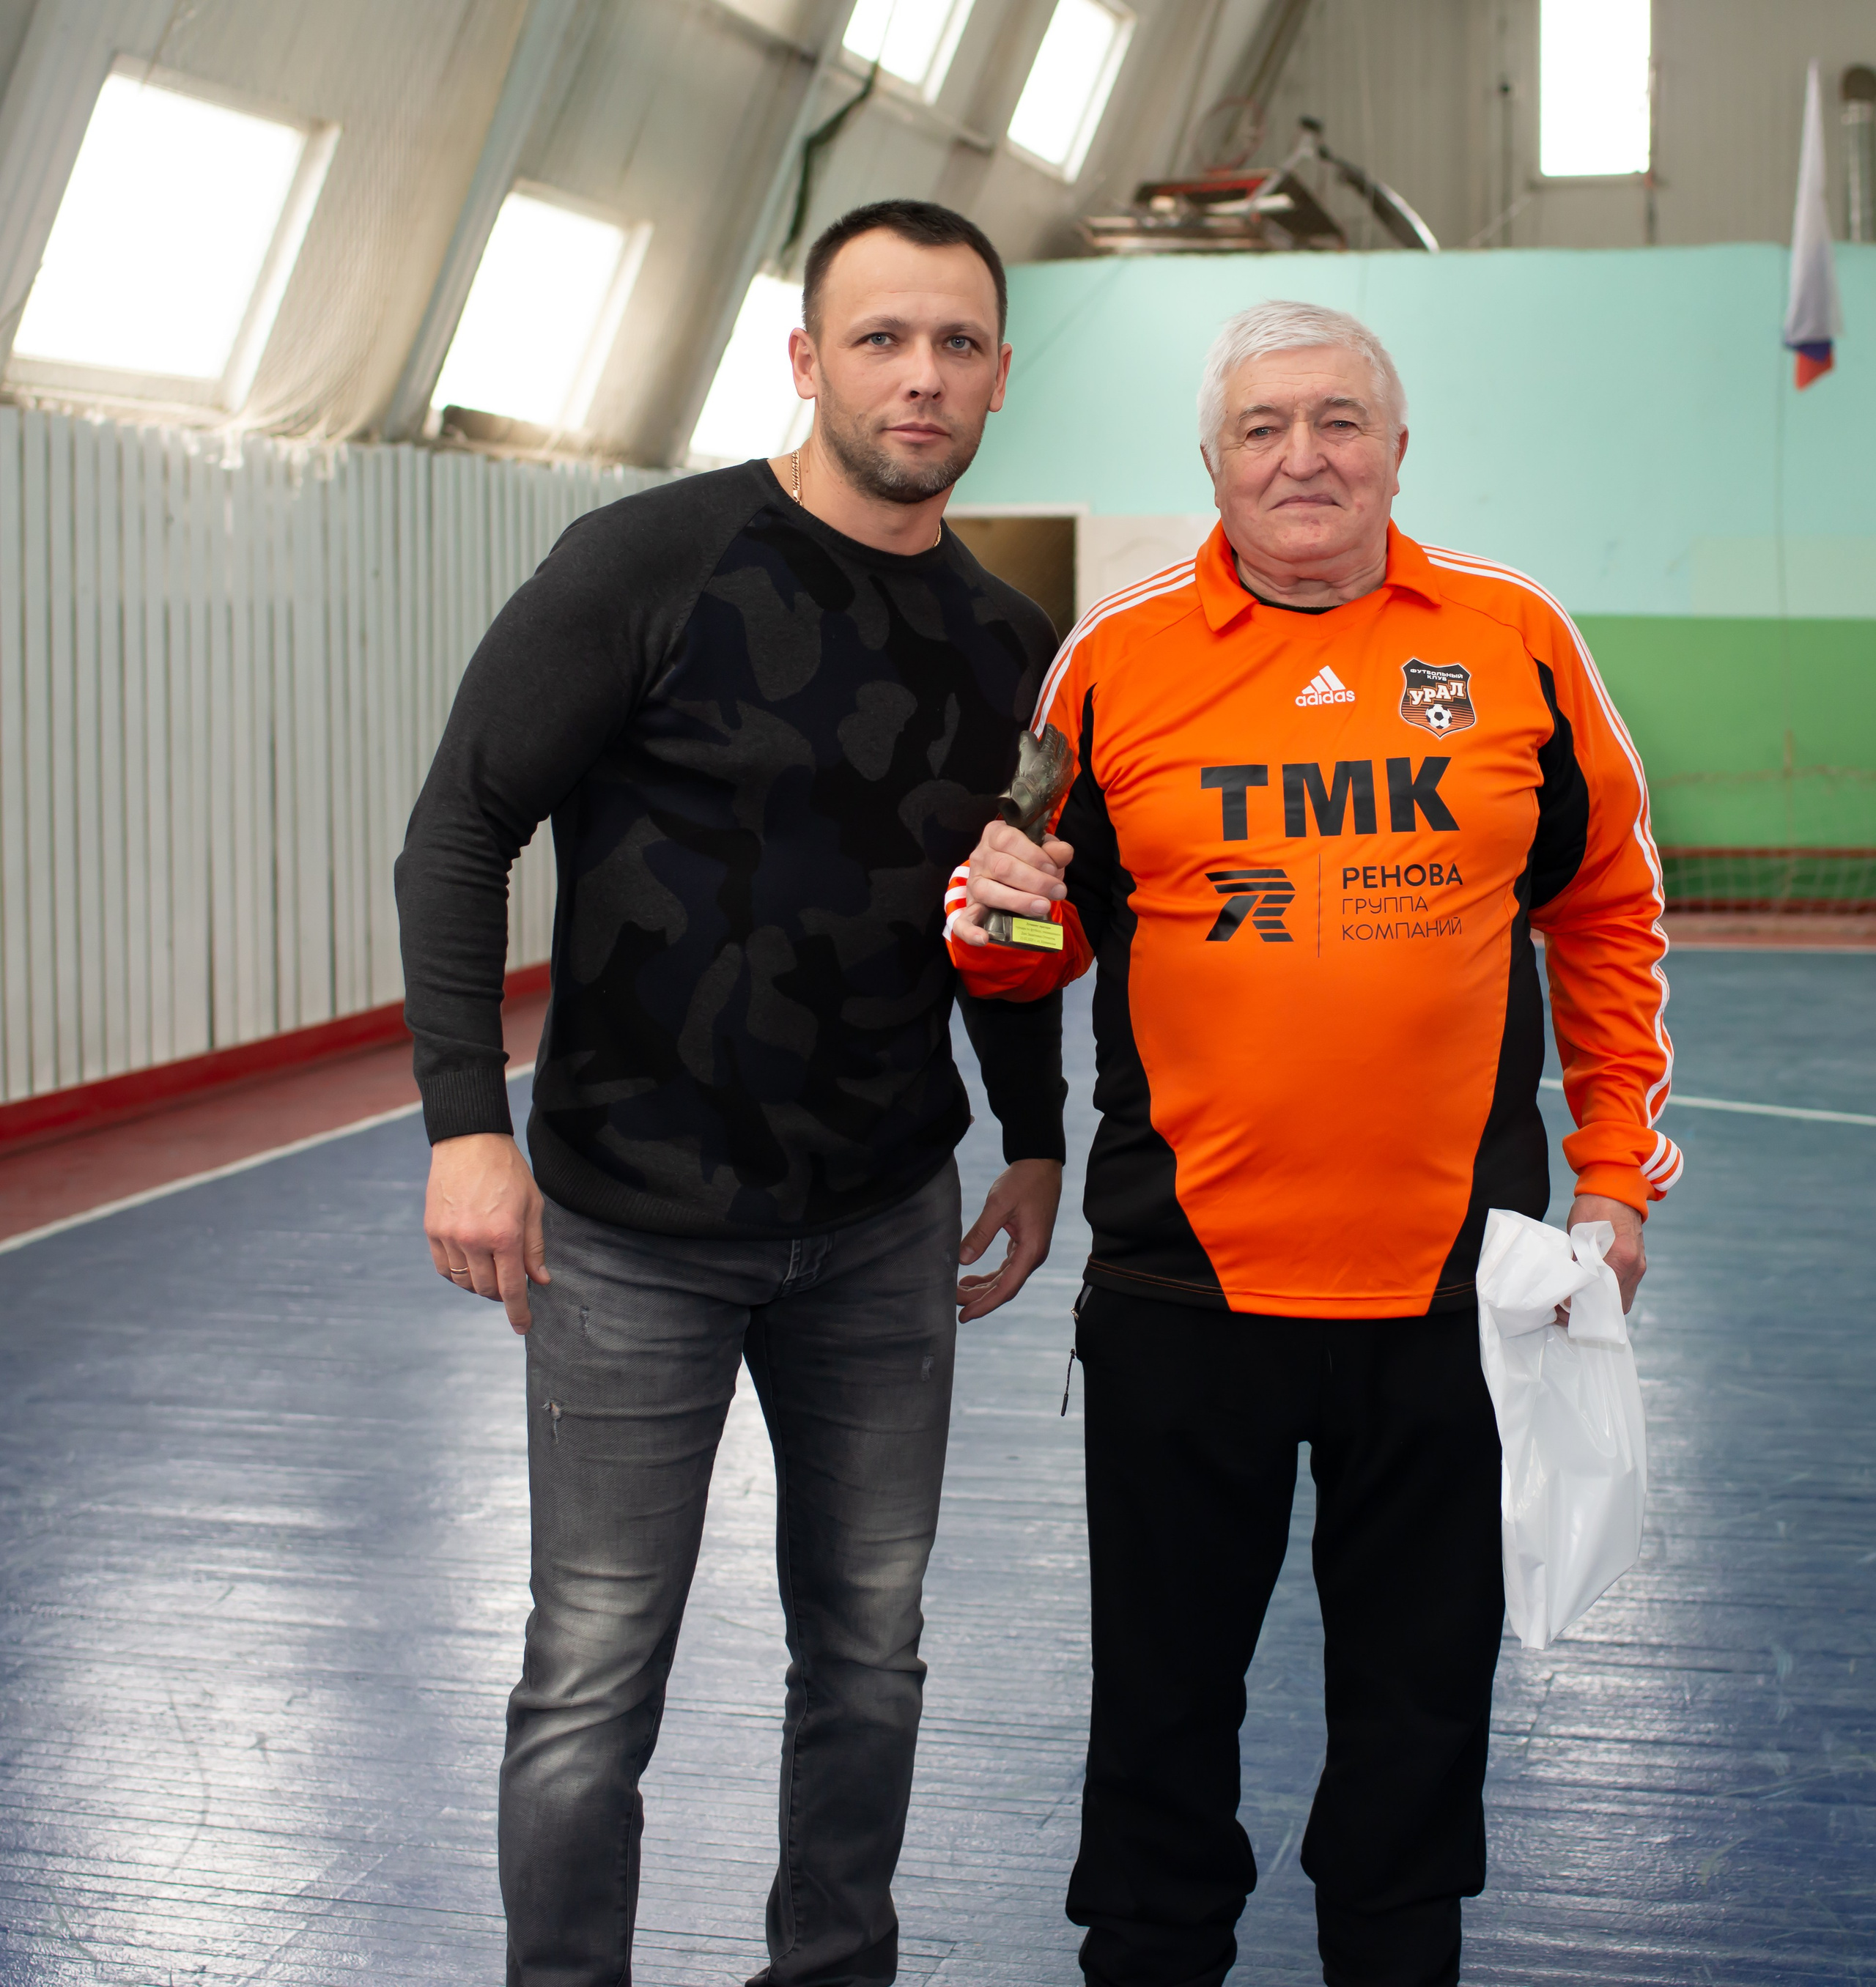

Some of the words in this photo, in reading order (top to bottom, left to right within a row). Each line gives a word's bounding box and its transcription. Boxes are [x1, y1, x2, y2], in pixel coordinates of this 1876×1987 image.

[1409, 668, 1463, 679] ФУТБОЛЬНЫЙ
[1295, 688, 1356, 707] adidas
[1408, 681, 1465, 706] УРАЛ
[1200, 756, 1461, 842] ТМК
[1343, 862, 1464, 890] РЕНОВА
[1342, 895, 1429, 915] ГРУППА
[1342, 916, 1463, 941] КОМПАНИЙ
